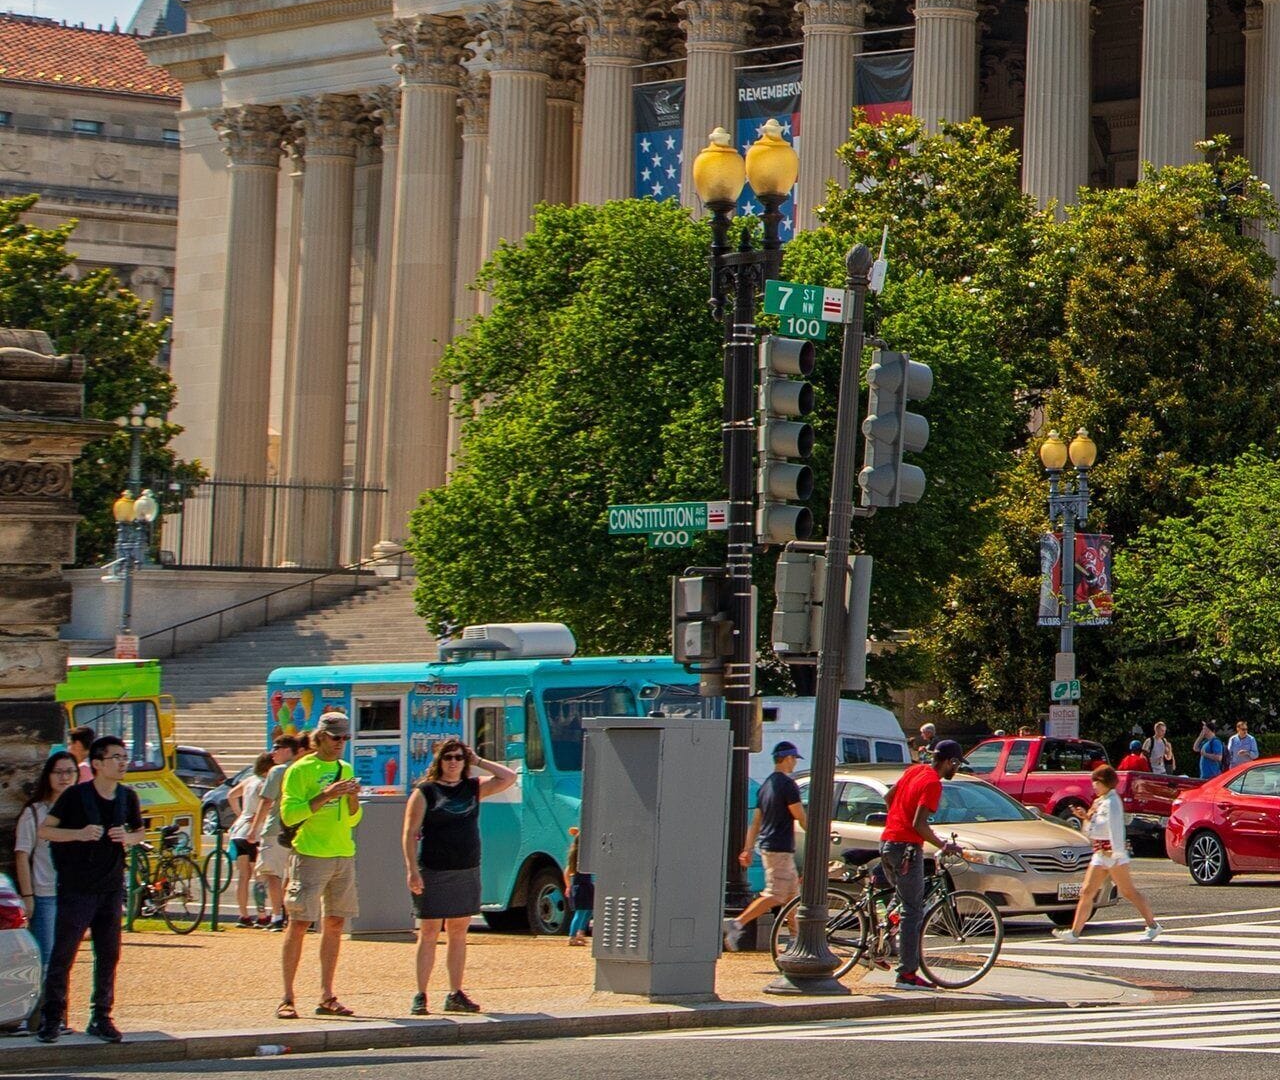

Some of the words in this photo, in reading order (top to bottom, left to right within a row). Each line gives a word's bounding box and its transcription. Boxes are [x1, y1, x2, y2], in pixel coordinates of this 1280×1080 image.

[778, 286, 793, 311] 7
[803, 288, 817, 301] ST
[802, 301, 815, 314] NW
[787, 317, 820, 337] 100
[609, 507, 694, 530] CONSTITUTION
[695, 506, 705, 515] AVE
[695, 517, 706, 527] NW
[652, 531, 689, 546] 700
[1052, 710, 1076, 718] NOTICE
